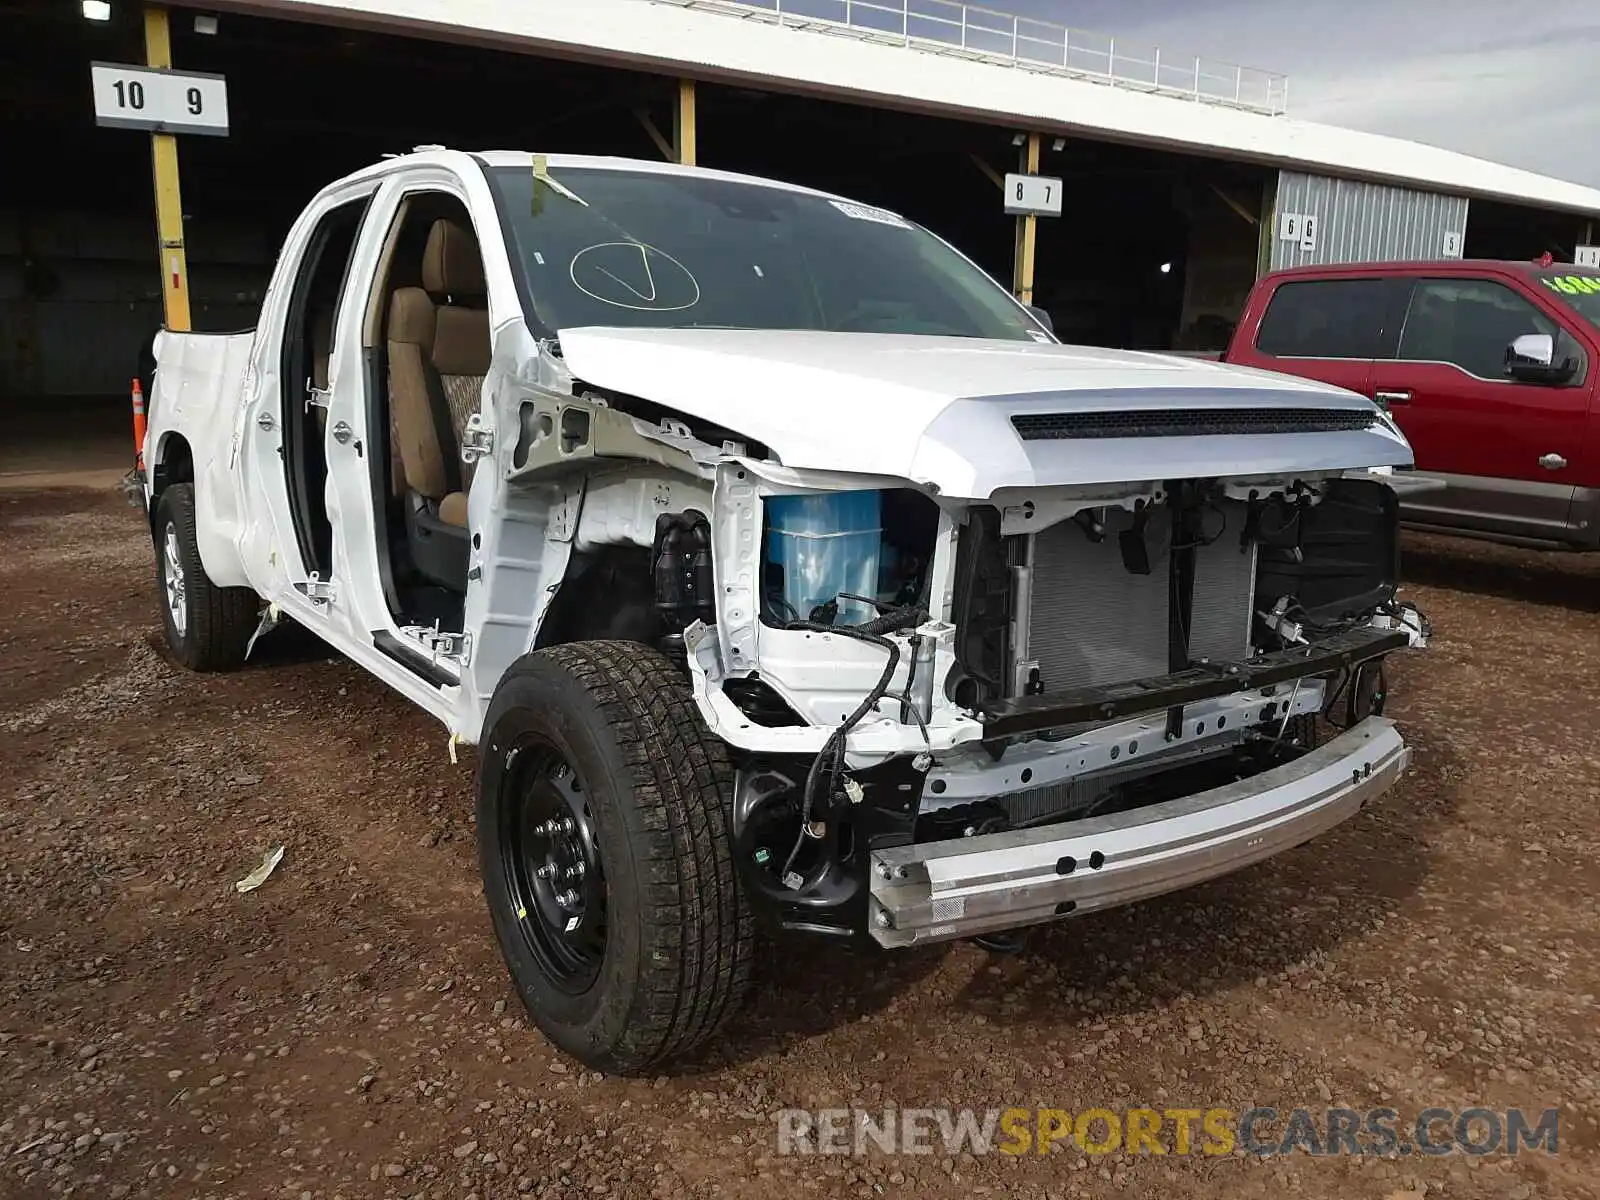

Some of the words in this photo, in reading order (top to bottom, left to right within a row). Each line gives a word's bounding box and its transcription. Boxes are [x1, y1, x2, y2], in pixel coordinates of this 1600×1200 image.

[113, 79, 144, 110] 10
[187, 87, 202, 115] 9
[1016, 182, 1024, 201] 8
[1045, 185, 1051, 204] 7
[1288, 219, 1295, 235] 6
[1449, 236, 1454, 251] 5
